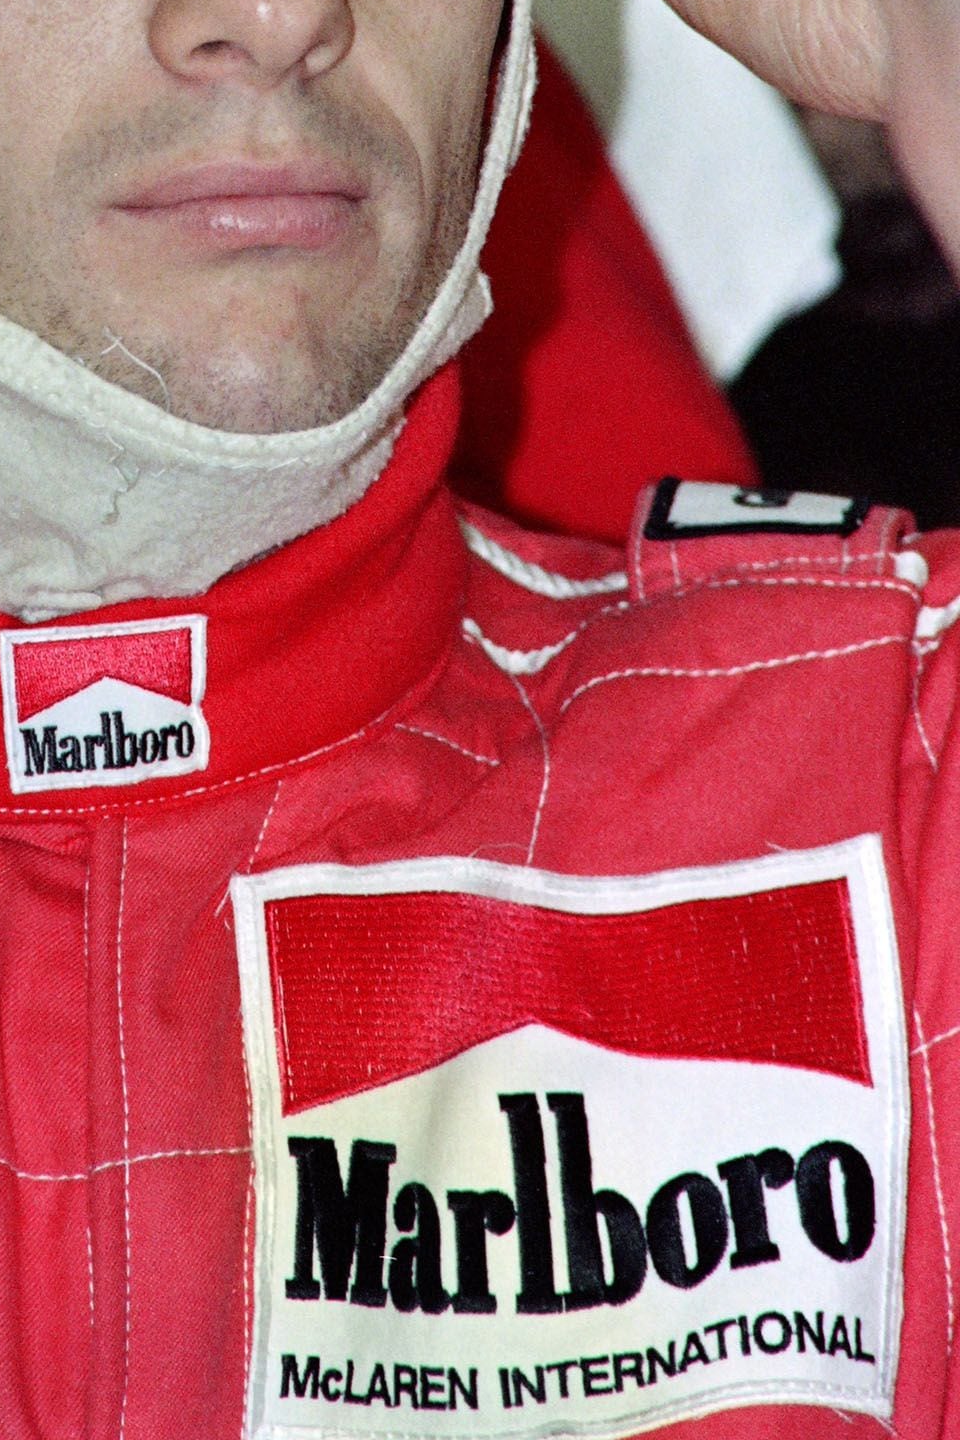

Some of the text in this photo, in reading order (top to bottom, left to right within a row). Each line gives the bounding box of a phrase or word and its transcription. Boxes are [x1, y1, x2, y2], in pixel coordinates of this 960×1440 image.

[20, 711, 195, 776] Marlboro
[284, 1092, 877, 1315] Marlboro
[280, 1311, 876, 1410] McLAREN INTERNATIONAL
